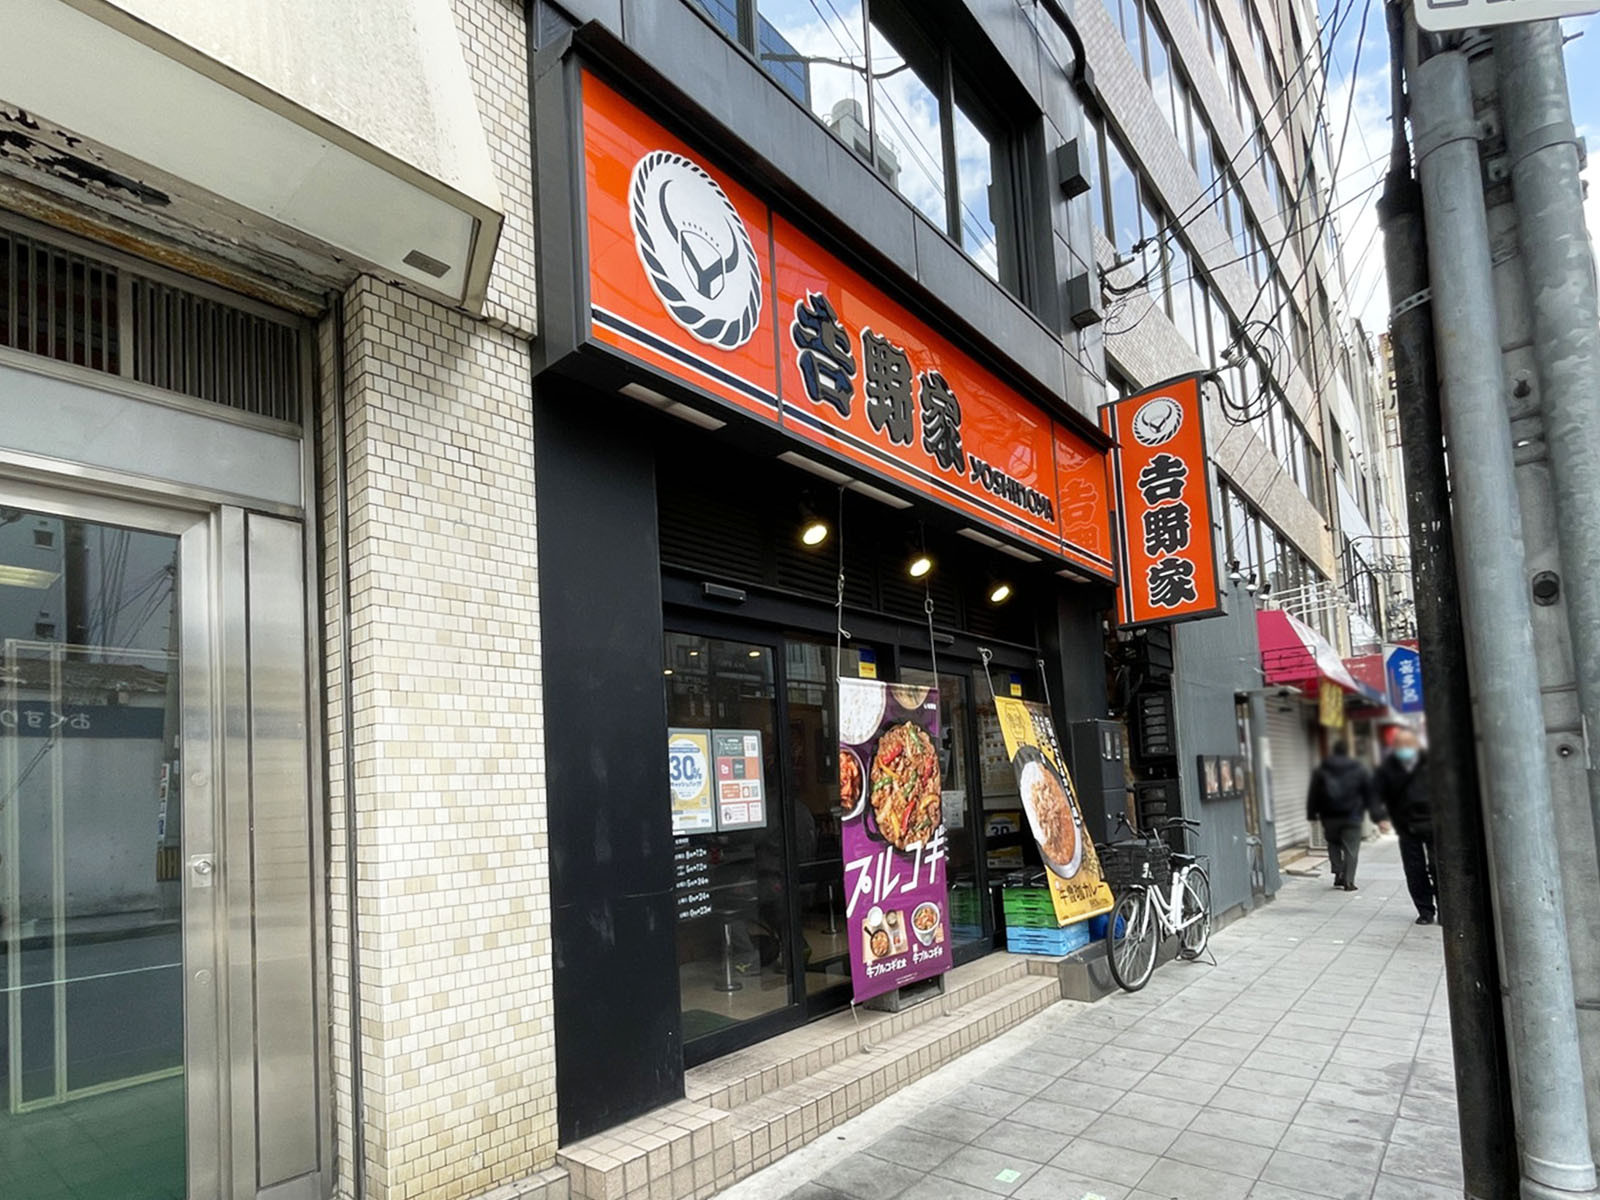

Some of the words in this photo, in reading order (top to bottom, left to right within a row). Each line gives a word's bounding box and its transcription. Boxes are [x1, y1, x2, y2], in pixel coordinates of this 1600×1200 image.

[791, 289, 967, 475] 吉野家
[968, 453, 1055, 523] YOSHINOYA
[1139, 453, 1197, 607] 吉野家
